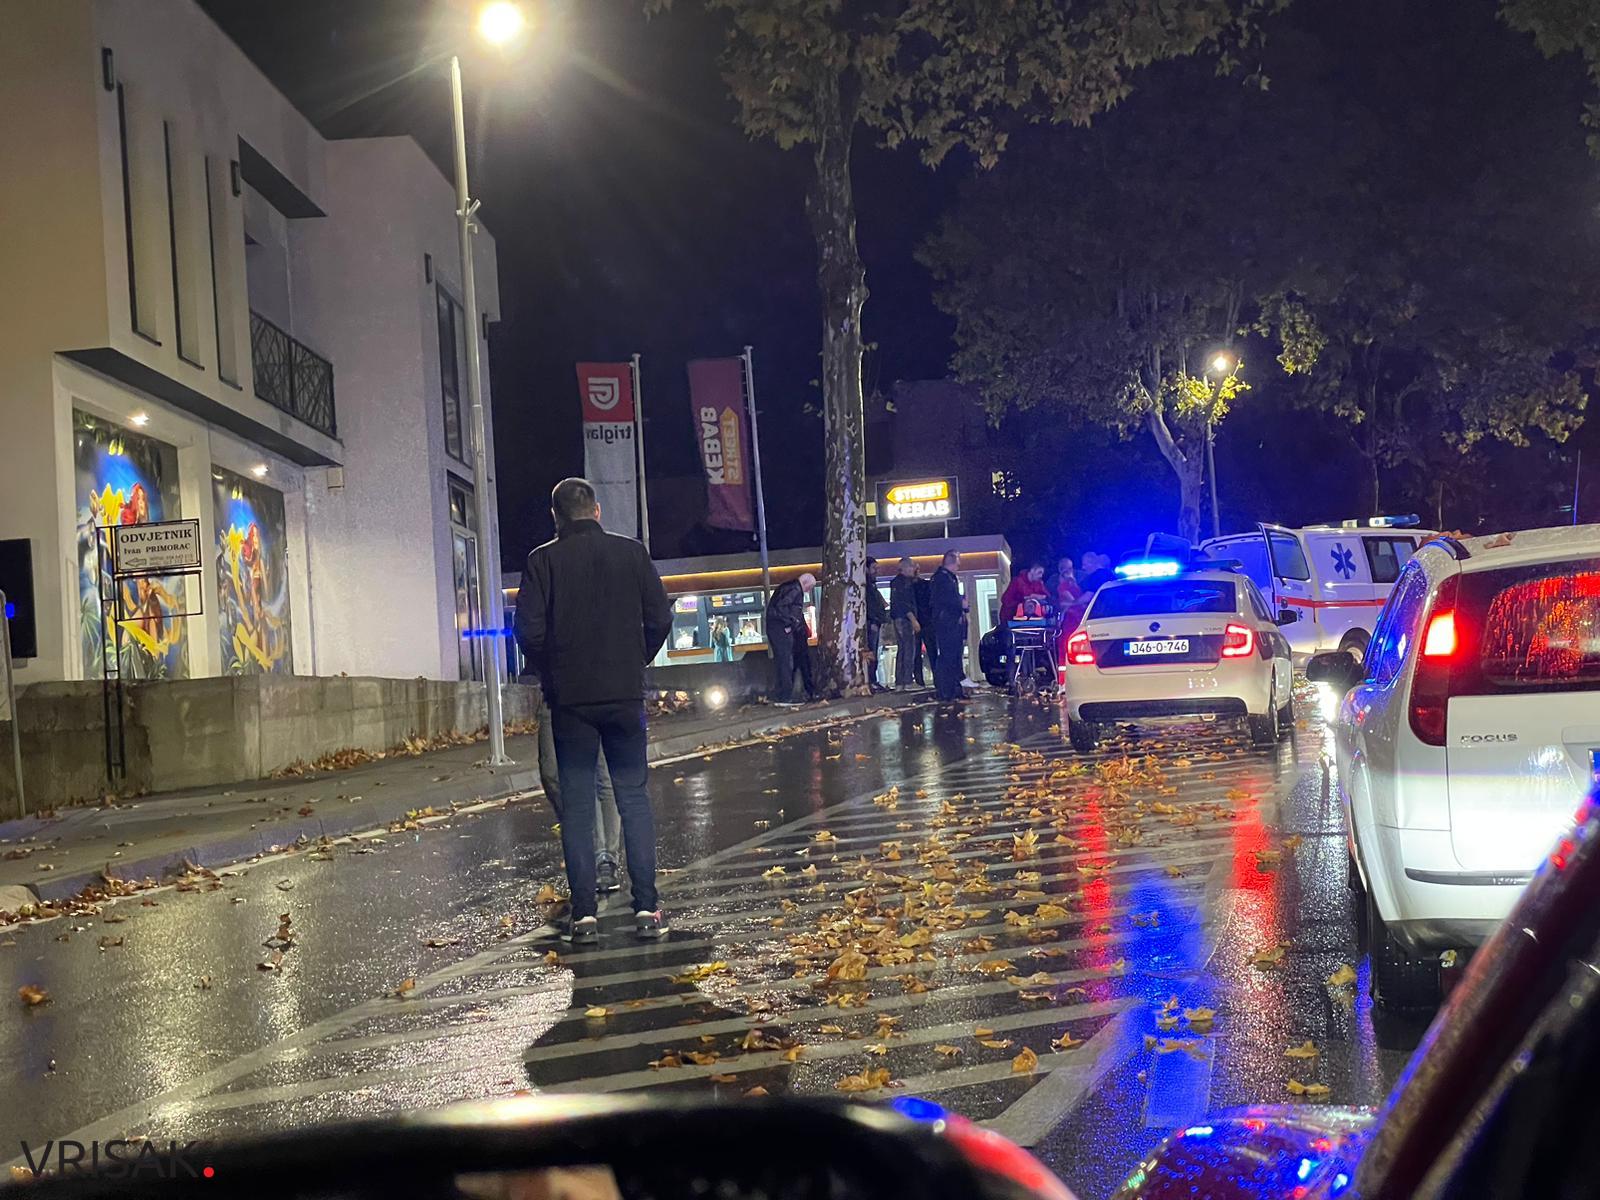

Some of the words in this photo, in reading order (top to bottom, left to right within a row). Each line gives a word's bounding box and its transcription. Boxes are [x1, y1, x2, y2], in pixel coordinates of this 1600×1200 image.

[894, 484, 944, 502] STREET
[886, 500, 949, 520] KEBAB
[120, 529, 193, 544] ODVJETNIK
[123, 547, 142, 555] Ivan
[145, 543, 191, 553] PRIMORAC
[1460, 733, 1518, 744] FOCUS
